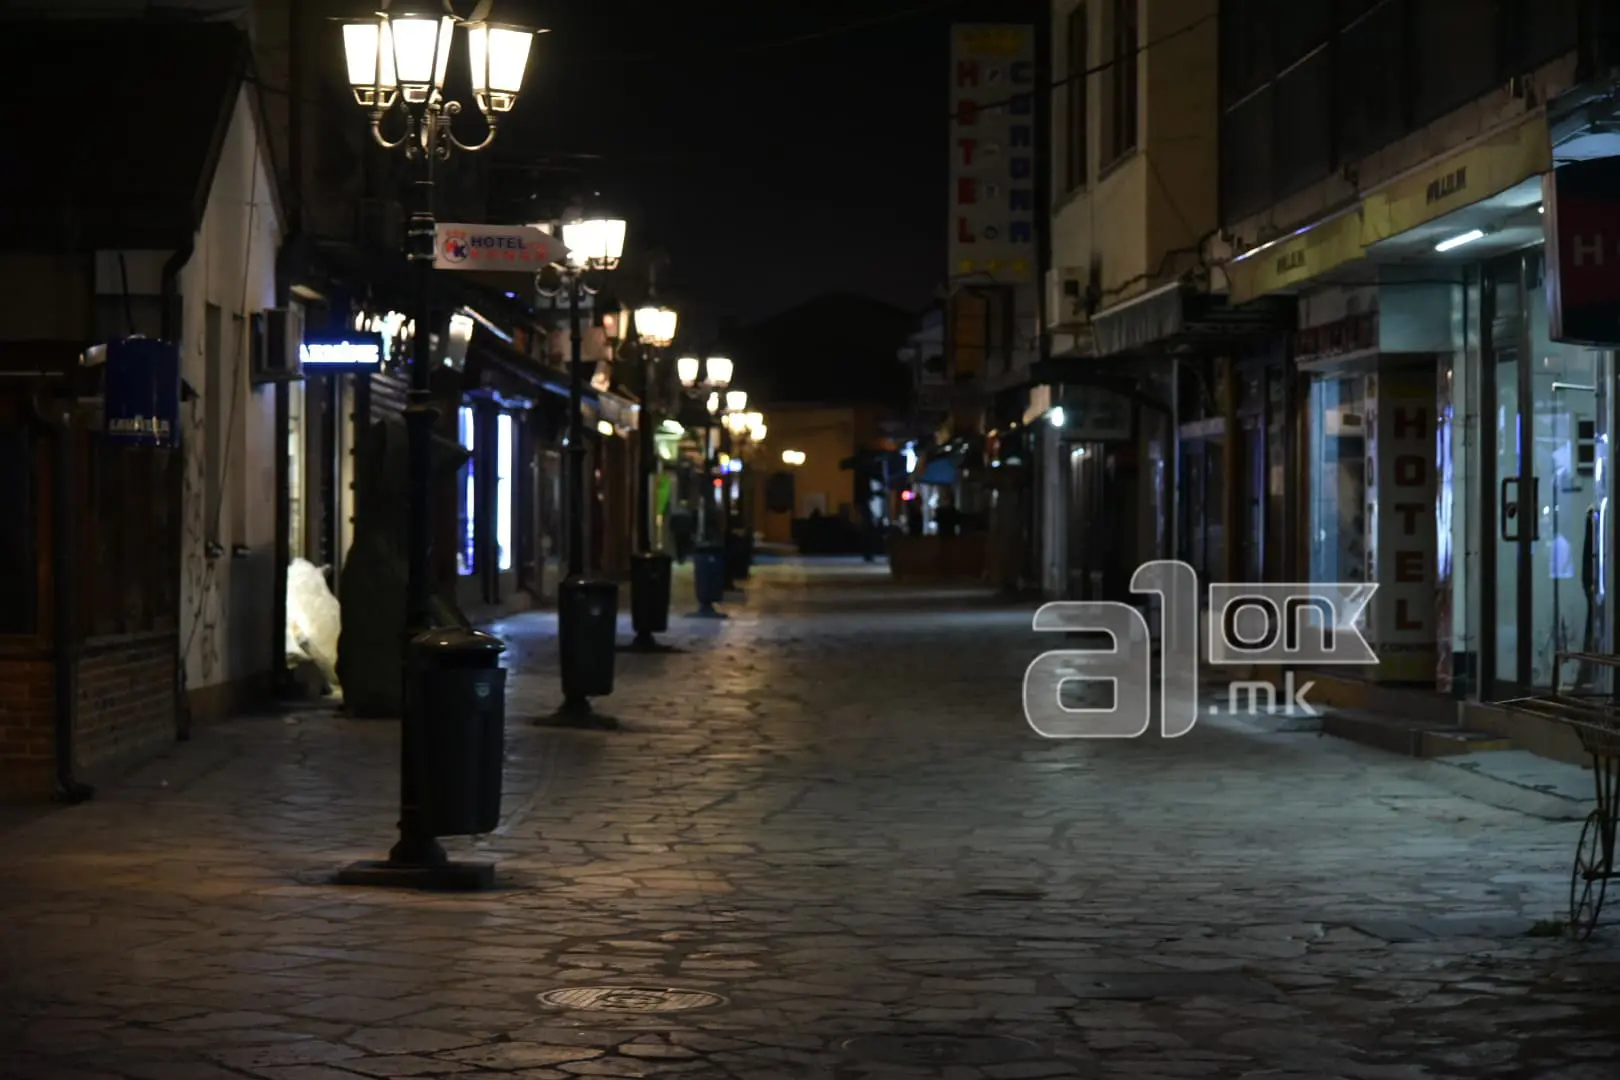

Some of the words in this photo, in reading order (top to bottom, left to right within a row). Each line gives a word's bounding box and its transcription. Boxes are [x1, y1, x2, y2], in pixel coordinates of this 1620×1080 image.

[470, 235, 527, 249] HOTEL
[957, 60, 979, 244] HOTEL
[1394, 407, 1427, 631] HOTEL
